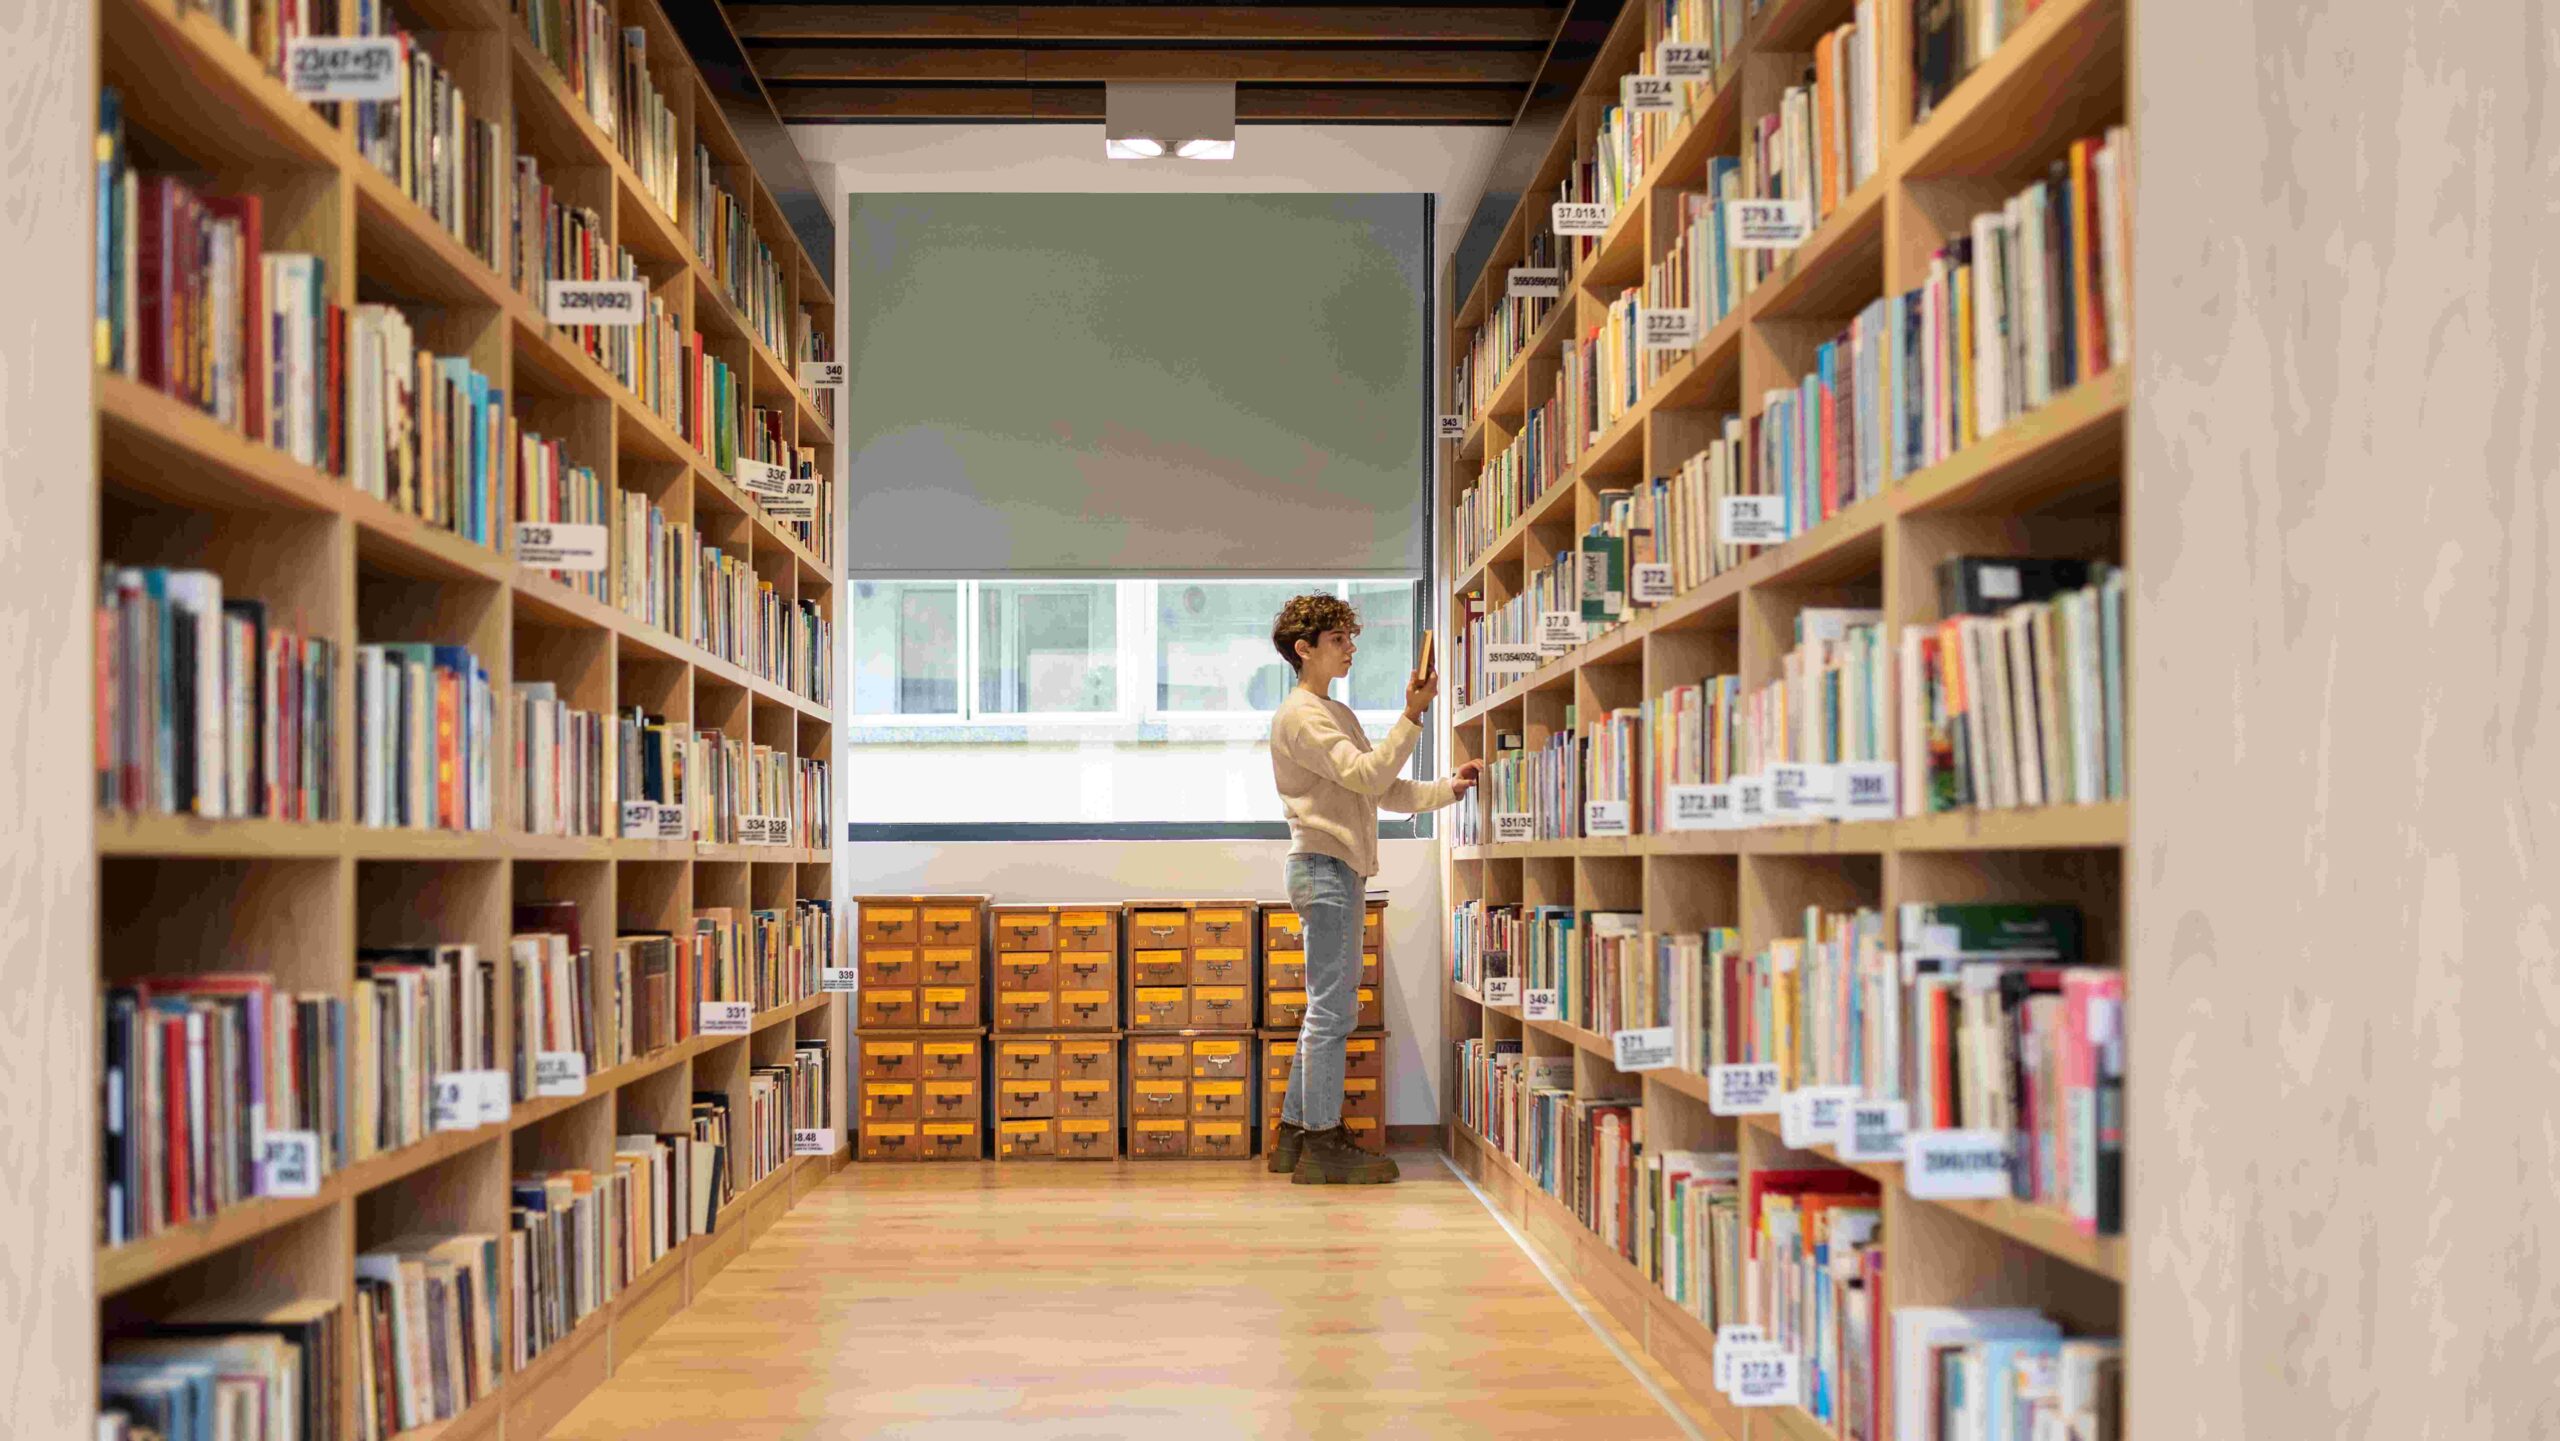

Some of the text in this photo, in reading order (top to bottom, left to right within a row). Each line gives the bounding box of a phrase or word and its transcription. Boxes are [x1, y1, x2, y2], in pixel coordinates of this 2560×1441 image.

[1634, 82, 1672, 94] 372.4
[1559, 207, 1606, 218] 37.018.1
[560, 291, 632, 312] 329(092)
[1647, 315, 1686, 329] 372.3
[826, 366, 842, 375] 340
[1442, 418, 1457, 426] 343
[767, 468, 786, 481] 336
[520, 528, 552, 544] 329
[1643, 571, 1665, 583] 372
[1546, 616, 1569, 627] 37.0
[659, 810, 682, 823] 330
[1592, 806, 1605, 818] 37
[747, 820, 766, 830] 334
[769, 820, 787, 832] 338
[839, 970, 855, 980] 339
[1490, 982, 1507, 992] 347
[726, 1007, 746, 1019] 331
[1622, 1035, 1644, 1049] 371
